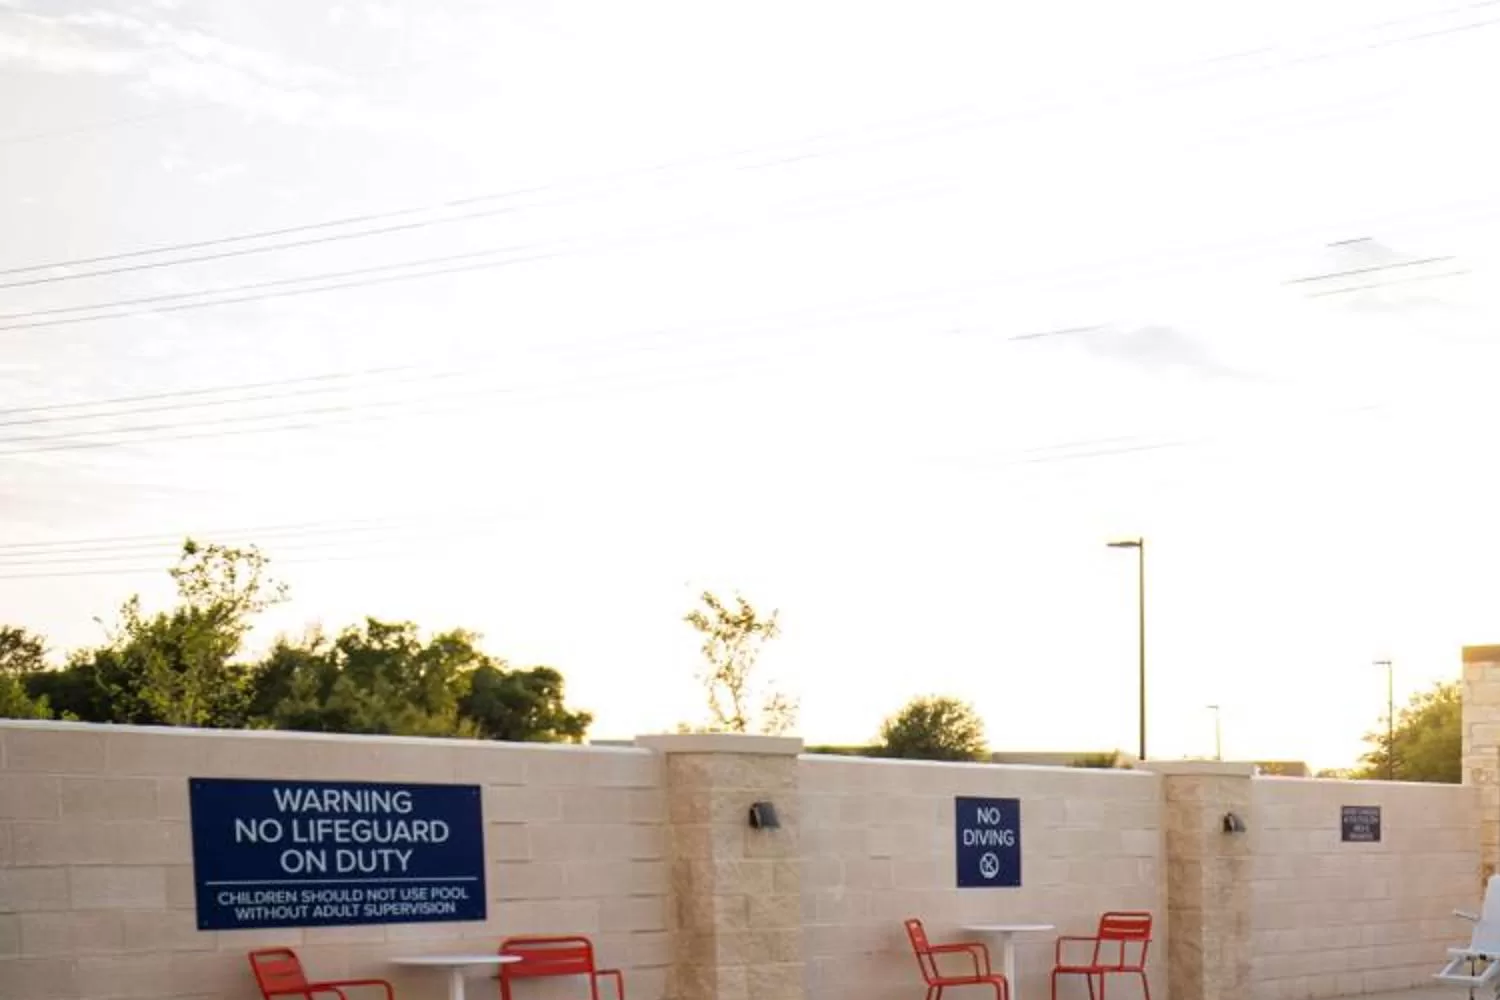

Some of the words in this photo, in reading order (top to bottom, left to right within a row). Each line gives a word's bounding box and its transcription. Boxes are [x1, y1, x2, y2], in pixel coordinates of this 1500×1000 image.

[273, 788, 413, 815] WARNING
[977, 807, 1001, 825] NO
[235, 818, 283, 843] NO
[293, 819, 449, 843] LIFEGUARD
[963, 829, 1016, 847] DIVING
[280, 850, 327, 873] ON
[336, 849, 413, 873] DUTY
[217, 890, 298, 906] CHILDREN
[301, 889, 363, 904] SHOULD
[367, 888, 397, 901] NOT
[401, 887, 428, 900] USE
[431, 886, 469, 899] POOL
[234, 905, 309, 921] WITHOUT
[313, 903, 360, 918] ADULT
[363, 901, 456, 917] SUPERVISION
